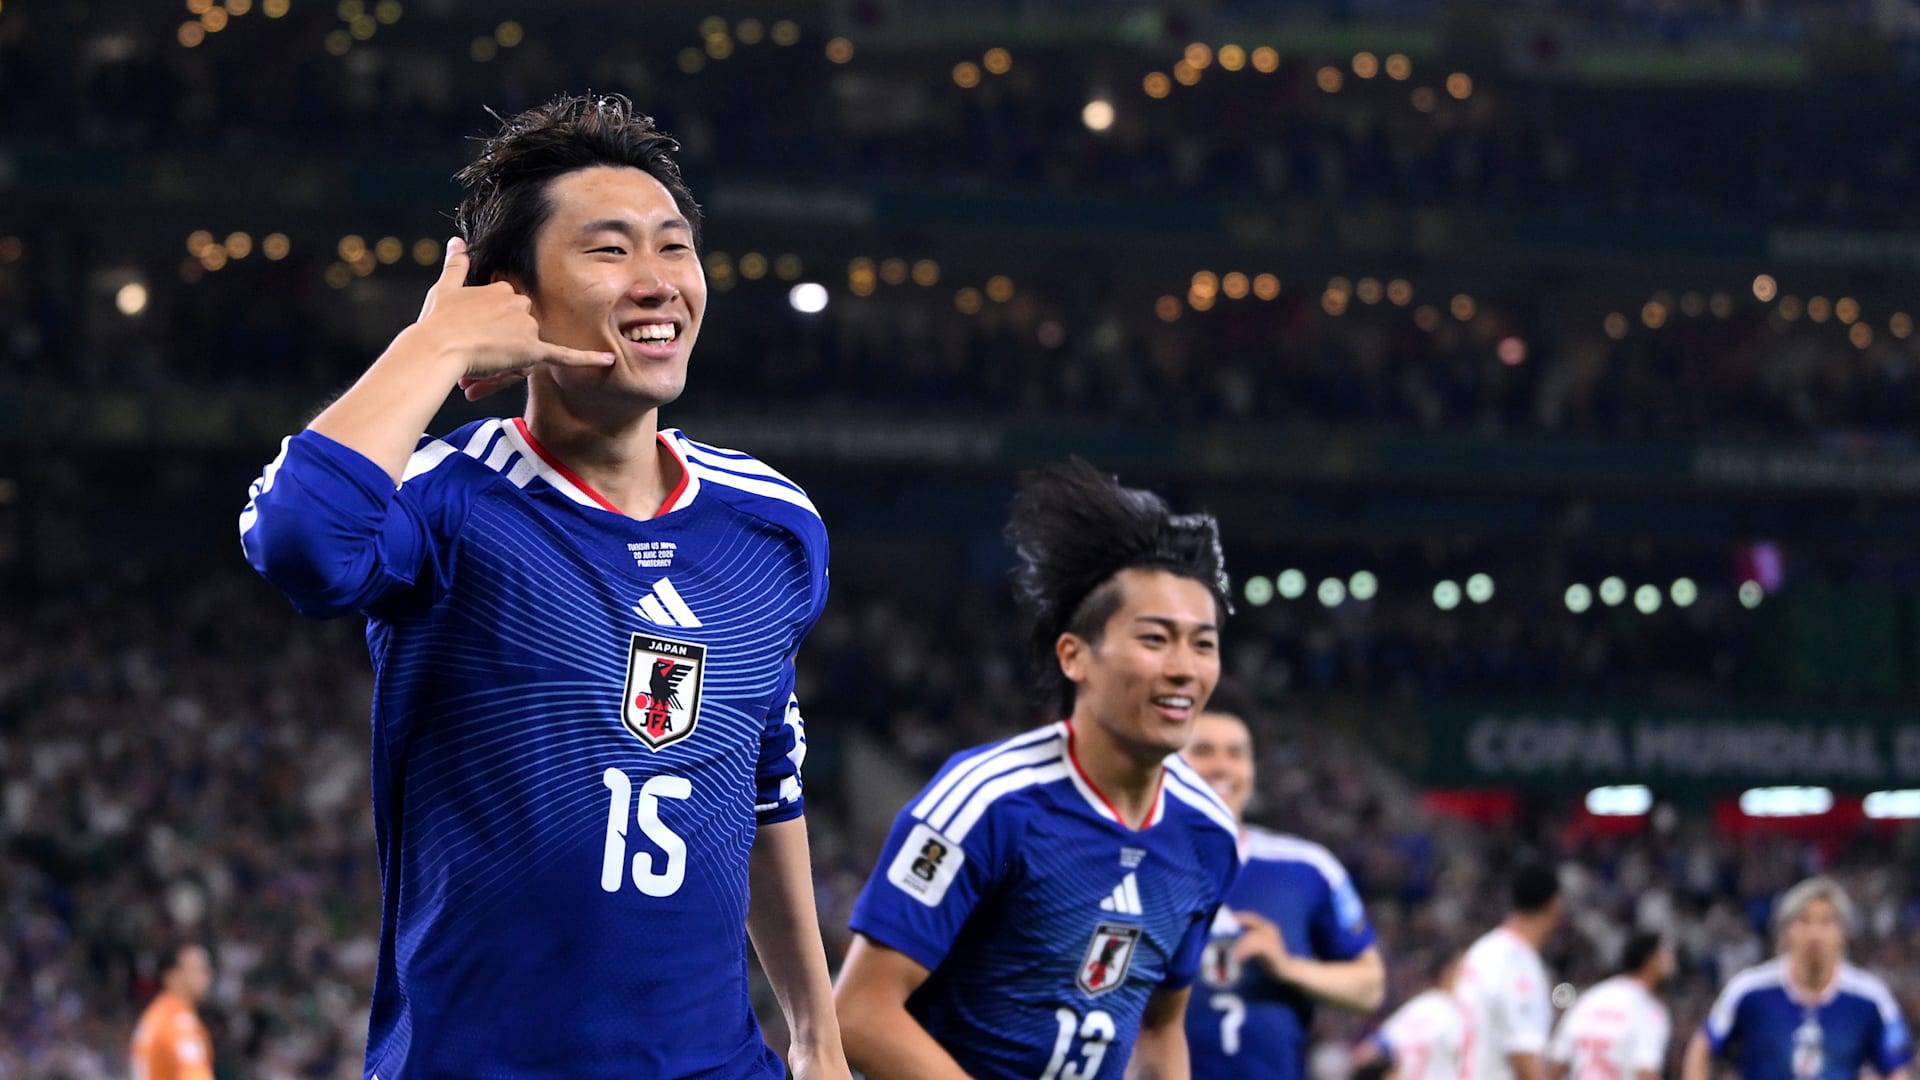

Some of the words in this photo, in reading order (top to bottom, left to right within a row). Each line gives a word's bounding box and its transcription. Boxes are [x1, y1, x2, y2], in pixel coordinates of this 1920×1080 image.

[627, 542, 650, 551] TUNISIA
[658, 550, 674, 558] 2026
[648, 640, 688, 656] JAPAN
[639, 712, 673, 732] JFA
[1466, 714, 1624, 772] COPA
[1633, 718, 1887, 777] MUNDIAL
[600, 767, 693, 897] 15
[1039, 1007, 1116, 1080] 13
[1209, 993, 1246, 1055] 7
